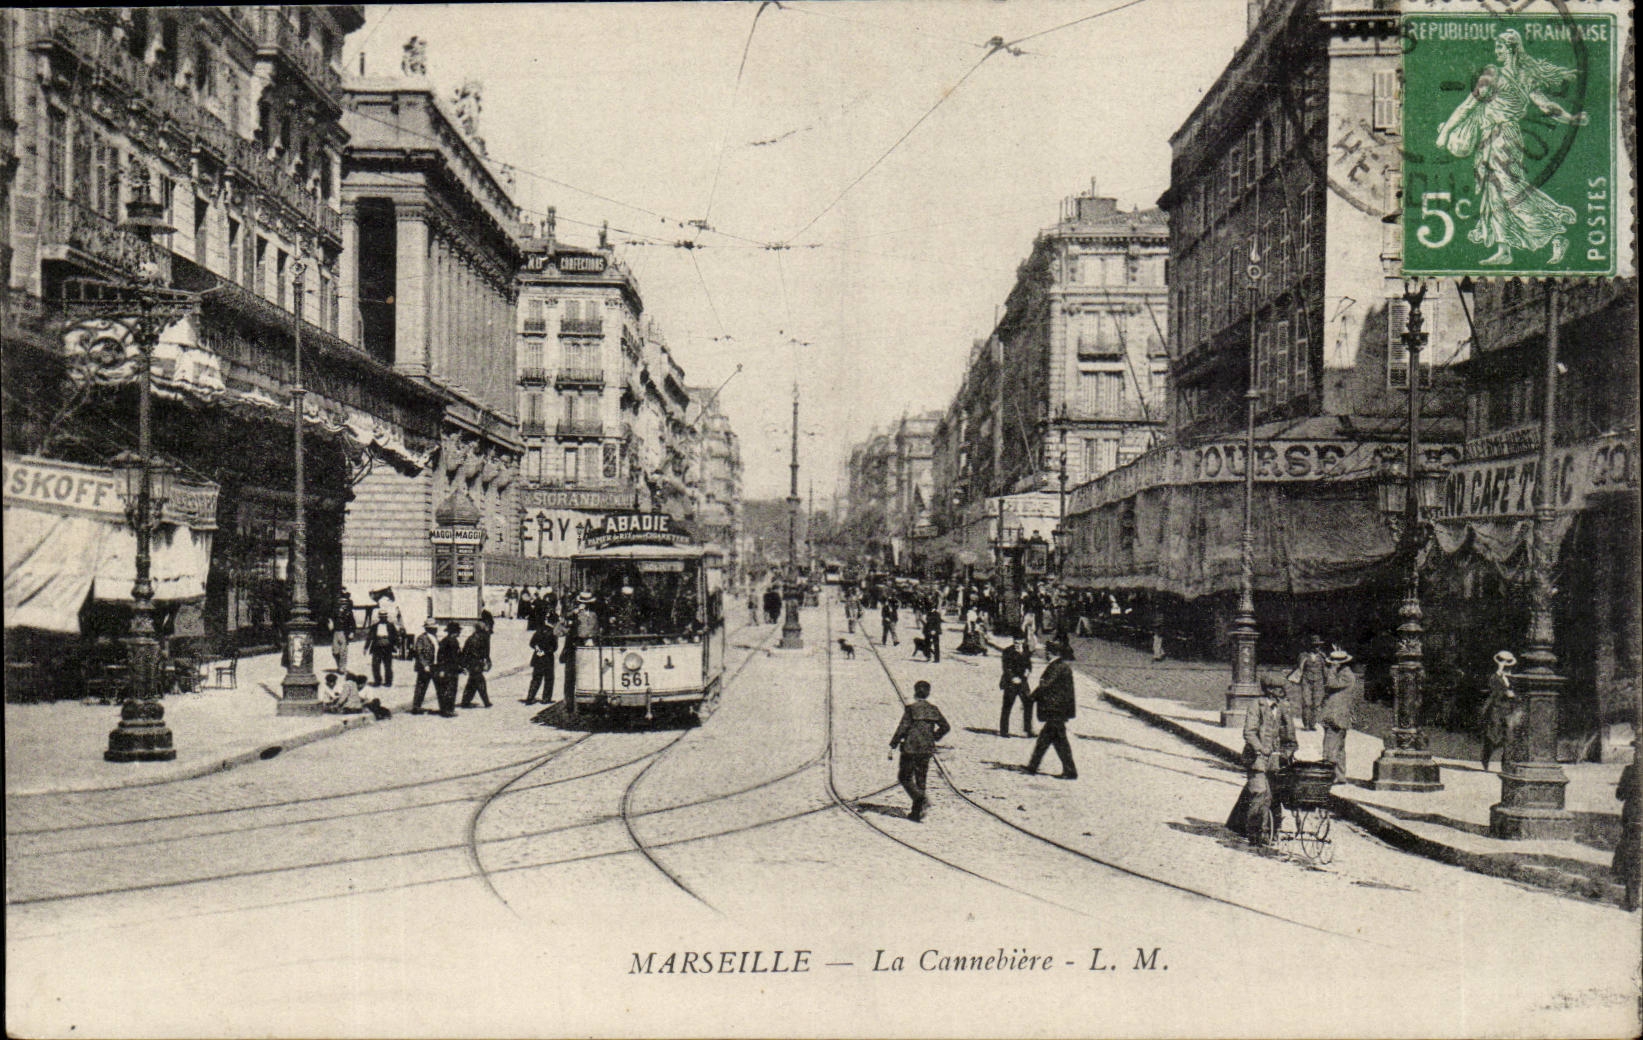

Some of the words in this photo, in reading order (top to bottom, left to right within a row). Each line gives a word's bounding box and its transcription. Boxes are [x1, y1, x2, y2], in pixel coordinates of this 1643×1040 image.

[1587, 176, 1607, 262] POSTES
[4, 464, 113, 506] SKOFF
[1516, 454, 1574, 511] TC
[430, 530, 453, 539] MAGGI
[455, 530, 481, 540] MAGGI
[606, 515, 669, 533] ABADIE
[621, 672, 651, 688] 561
